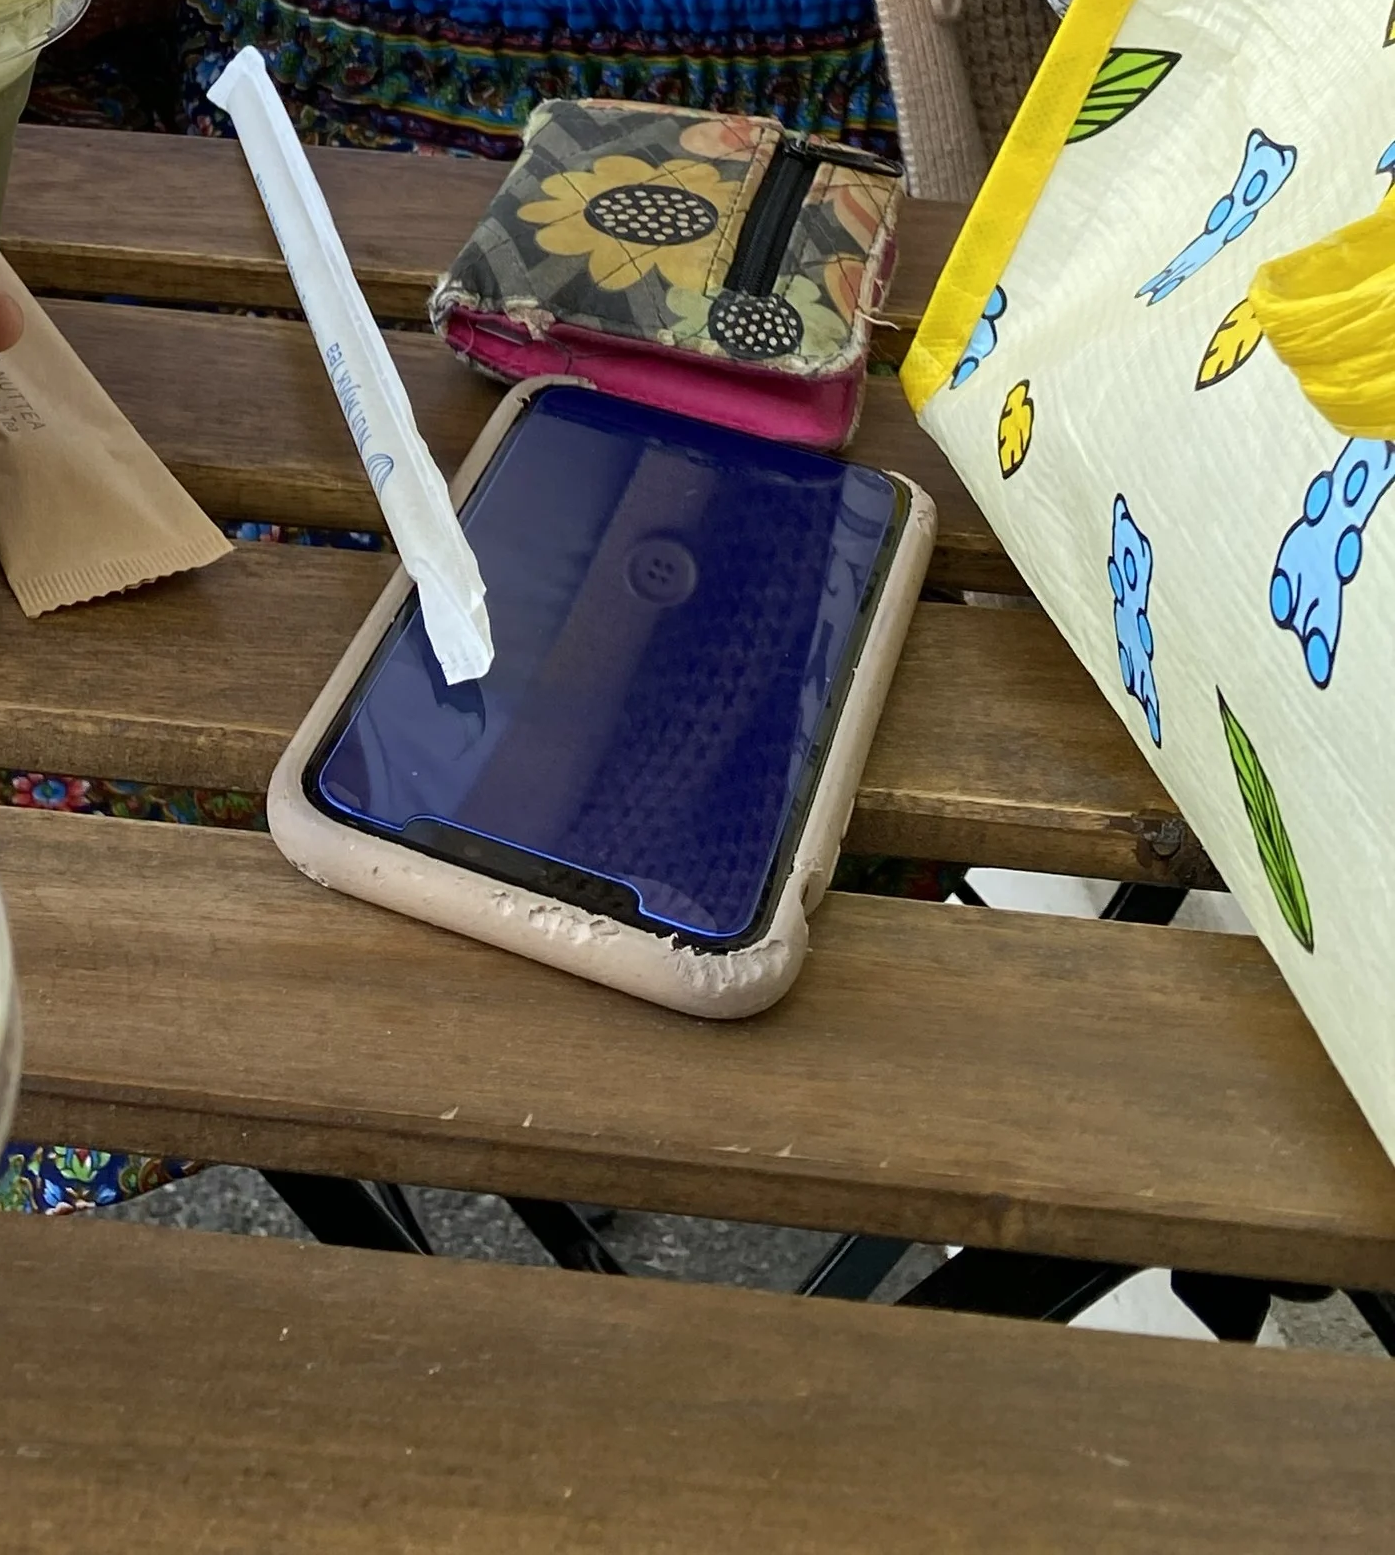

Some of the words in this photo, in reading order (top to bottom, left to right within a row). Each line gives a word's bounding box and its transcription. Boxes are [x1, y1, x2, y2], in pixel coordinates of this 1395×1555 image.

[326, 342, 347, 382] Tea
[0, 416, 19, 432] Tea
[352, 409, 373, 454] Nut
